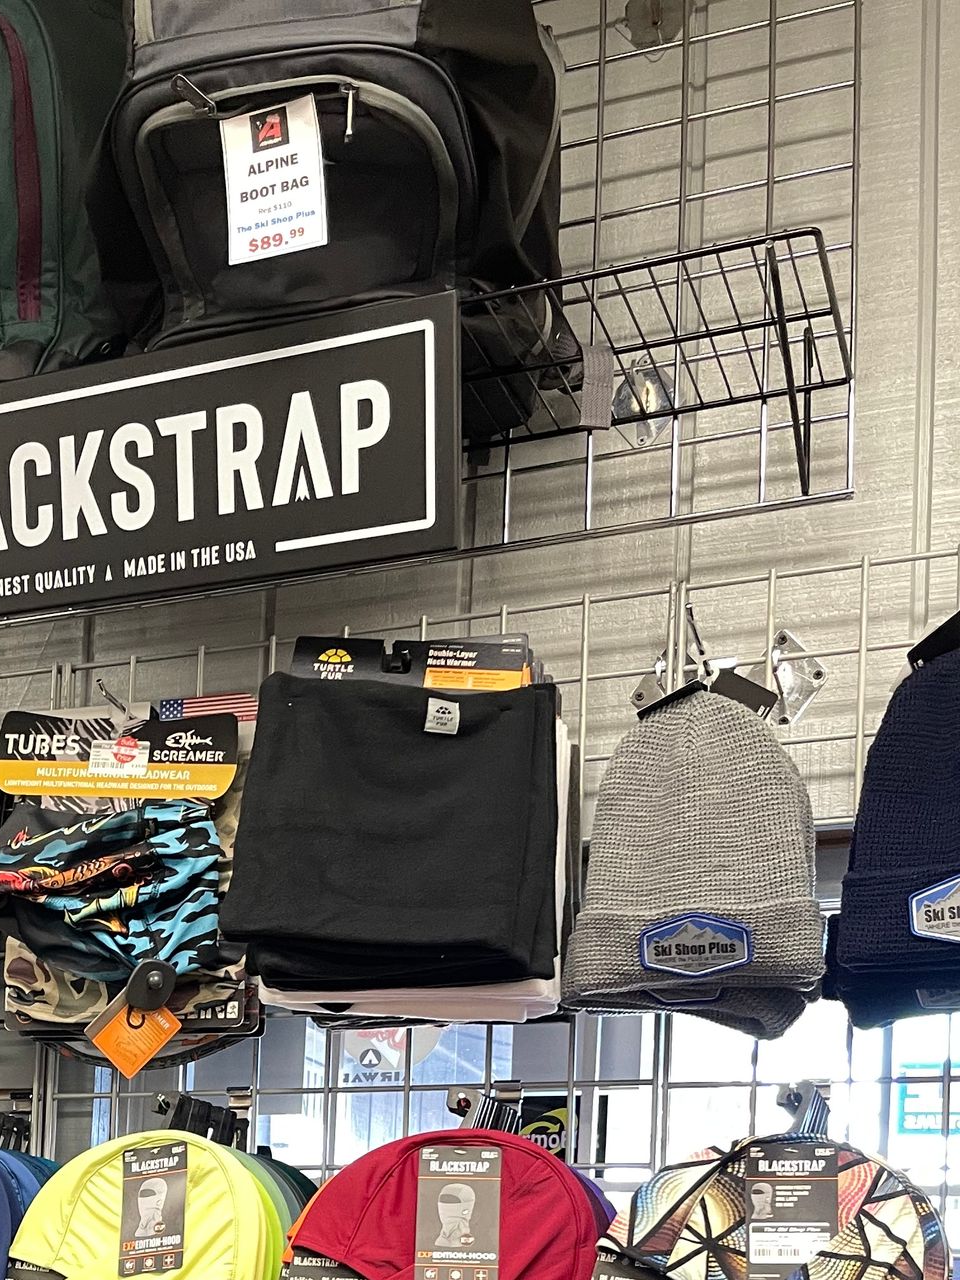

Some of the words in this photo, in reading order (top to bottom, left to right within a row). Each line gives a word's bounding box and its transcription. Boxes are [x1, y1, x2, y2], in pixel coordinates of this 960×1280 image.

[247, 153, 299, 176] ALPINE
[240, 184, 277, 203] BOOT
[281, 175, 310, 193] BAG
[273, 200, 292, 212] $110
[236, 224, 252, 234] The
[254, 219, 269, 230] Ski
[271, 213, 294, 225] Shop
[295, 209, 316, 219] Plus
[248, 227, 305, 253] $89.99
[35, 565, 96, 594] QUALITY
[123, 553, 166, 579] MADE
[170, 550, 186, 572] IN
[191, 545, 220, 568] THE
[225, 540, 256, 563] USA
[428, 649, 478, 659] Double-Layer
[312, 663, 355, 673] TURTLE
[427, 657, 446, 667] Neck
[446, 658, 477, 667] Warmer
[320, 671, 343, 680] FUR
[4, 733, 81, 756] TUBES
[153, 750, 224, 762] SCREAMER
[924, 907, 945, 923] Ski
[653, 944, 672, 957] Ski
[675, 943, 706, 956] Shop
[708, 942, 737, 955] Plus
[131, 1156, 179, 1173] BLACKSTRAP
[429, 1160, 490, 1173] BLACKSTRAP
[758, 1159, 826, 1173] BLACKSTRAP
